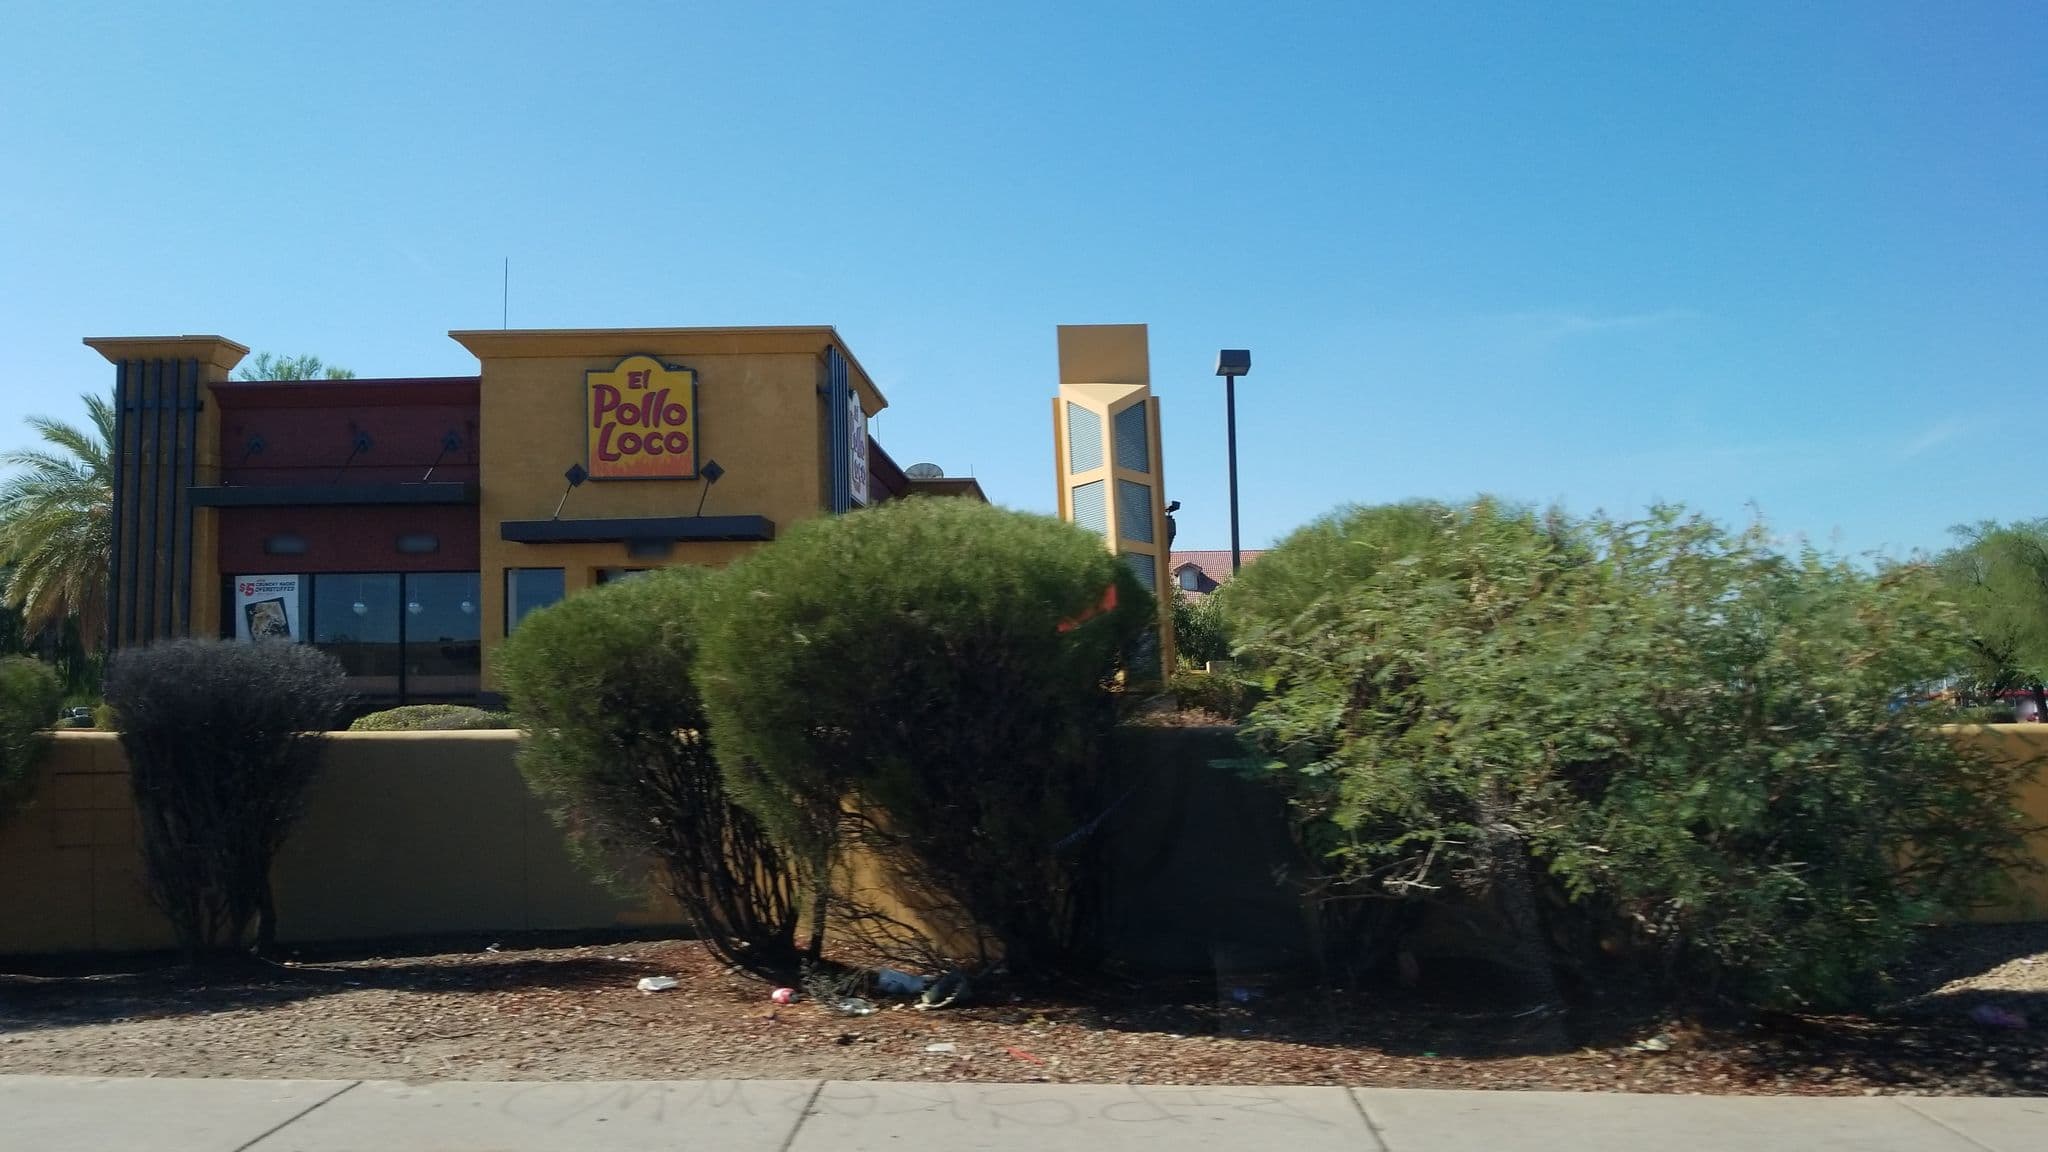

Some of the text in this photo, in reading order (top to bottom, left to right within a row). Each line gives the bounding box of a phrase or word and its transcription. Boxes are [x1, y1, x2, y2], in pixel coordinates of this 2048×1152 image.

[627, 369, 652, 390] El
[592, 383, 688, 429] Pollo
[597, 421, 689, 462] Loco
